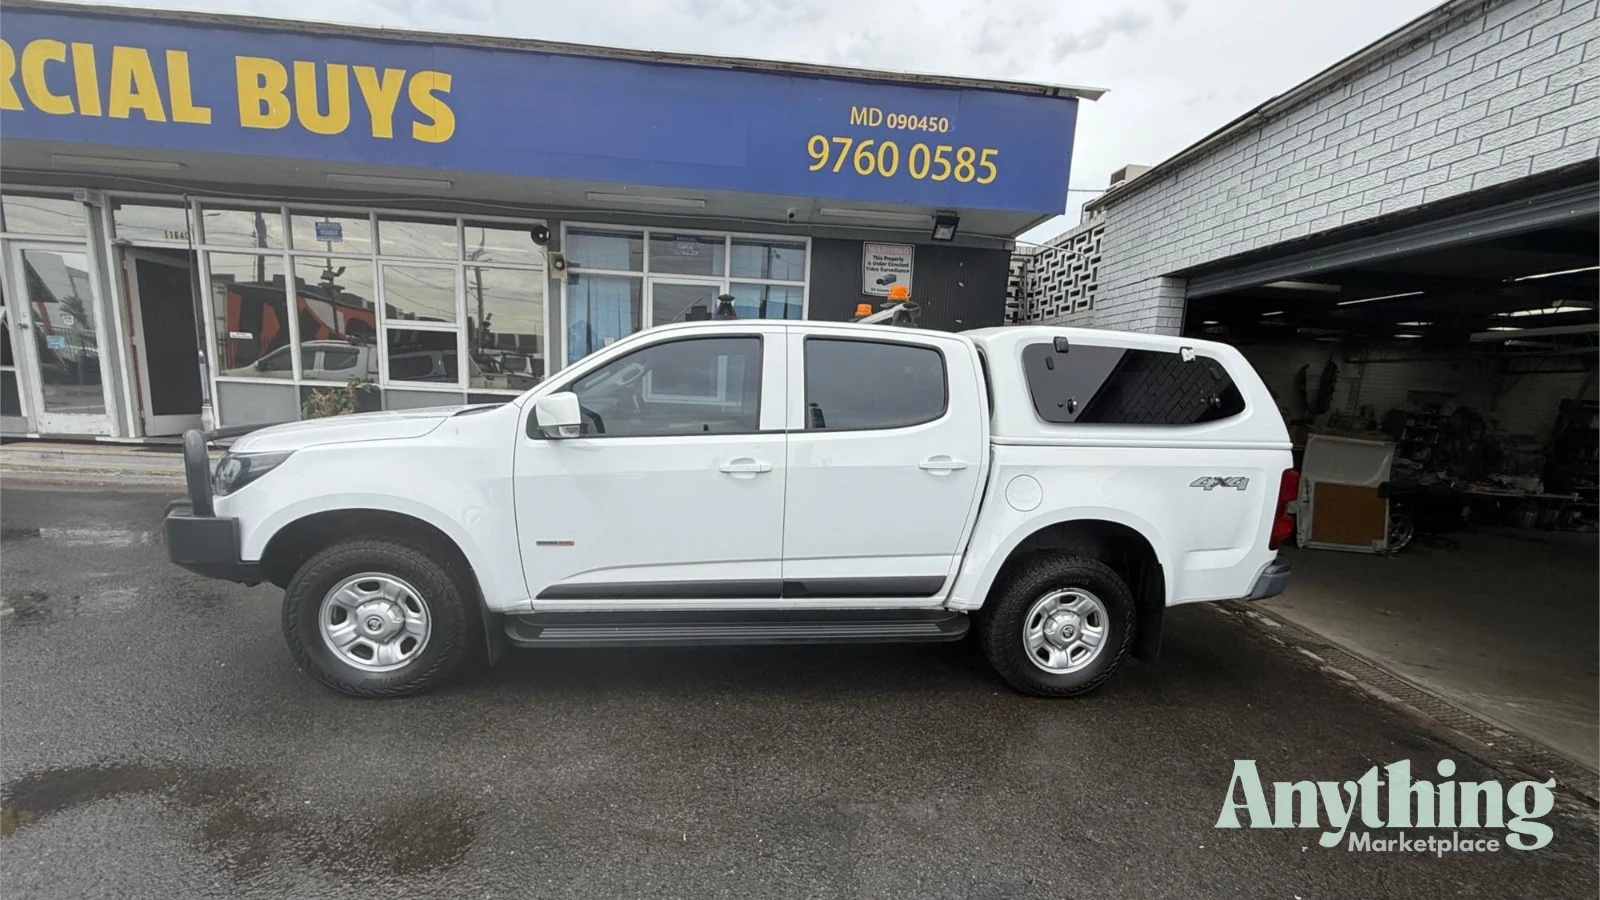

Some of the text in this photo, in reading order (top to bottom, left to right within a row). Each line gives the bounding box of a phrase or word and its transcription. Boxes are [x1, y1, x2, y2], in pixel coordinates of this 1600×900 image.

[235, 55, 456, 143] BUYS
[850, 106, 949, 133] MD 090450
[807, 134, 999, 184] 9760 0585
